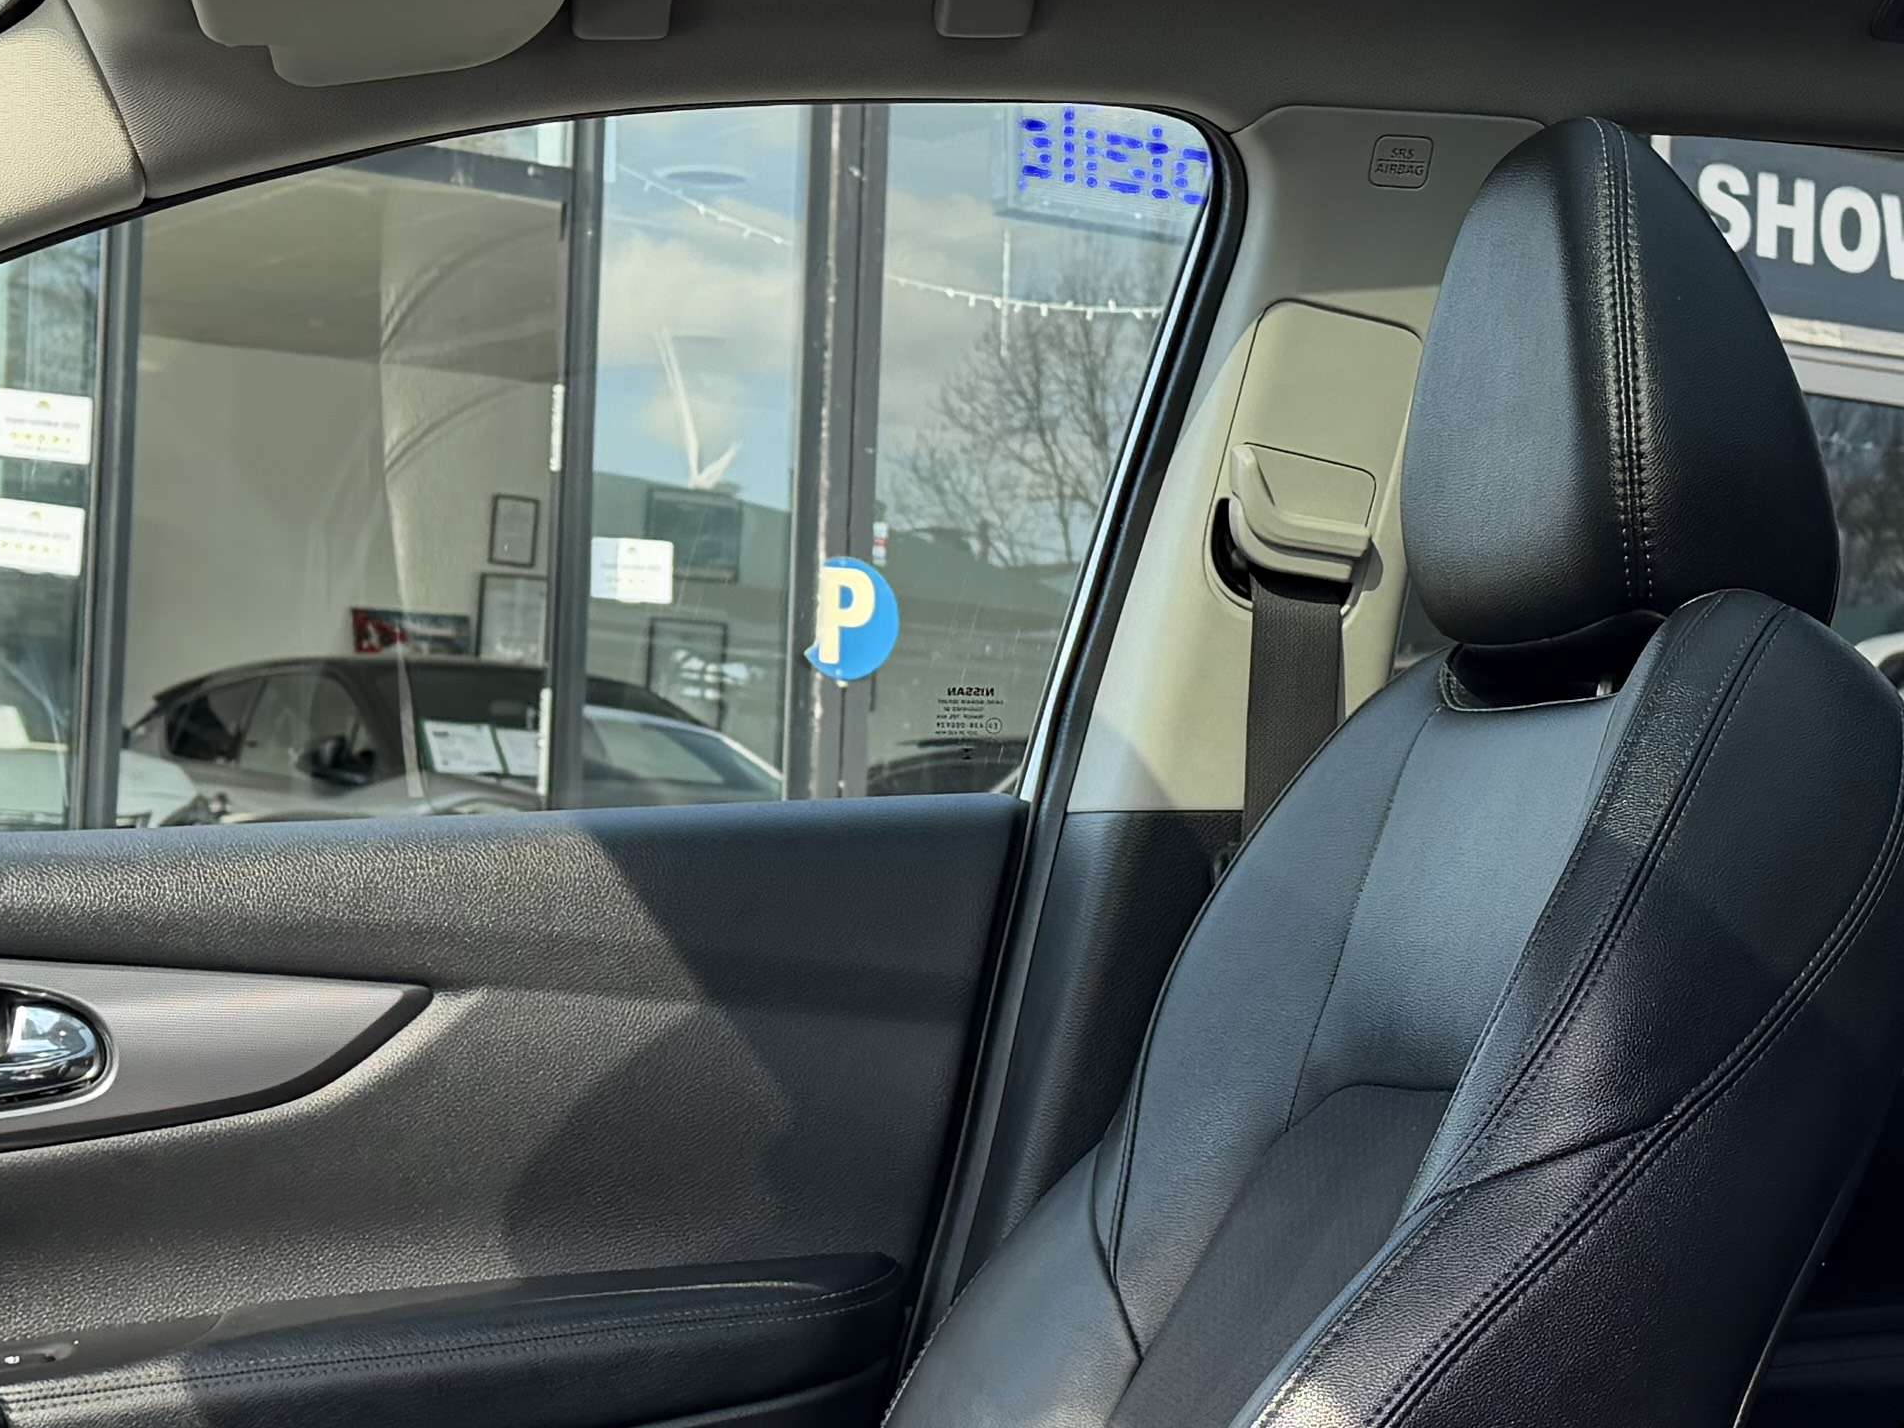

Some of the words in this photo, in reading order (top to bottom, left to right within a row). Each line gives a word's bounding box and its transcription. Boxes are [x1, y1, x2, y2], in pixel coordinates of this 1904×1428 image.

[1391, 147, 1415, 160] SRS
[1374, 162, 1425, 177] AIRBAG
[817, 566, 876, 665] P
